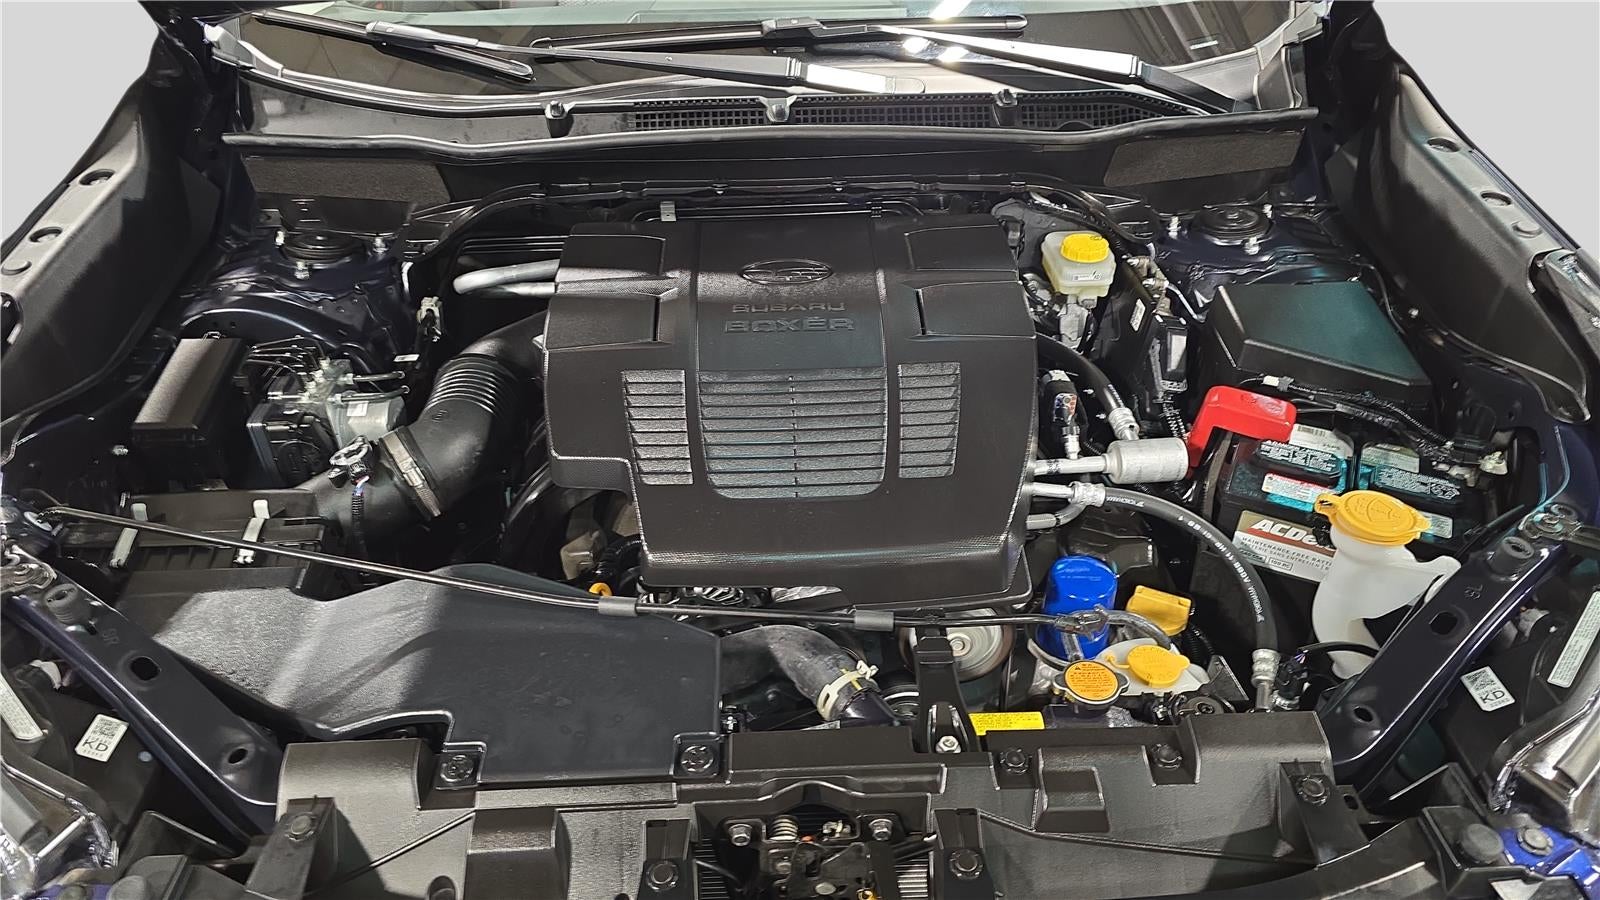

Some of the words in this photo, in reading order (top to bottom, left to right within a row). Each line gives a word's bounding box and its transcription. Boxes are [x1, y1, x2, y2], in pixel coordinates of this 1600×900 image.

[731, 302, 846, 314] SUBARU
[1250, 518, 1337, 553] ACDe
[1242, 535, 1290, 554] MAINTENANCE
[1291, 551, 1309, 560] FREE
[1480, 689, 1505, 703] KD
[82, 738, 108, 752] KD
